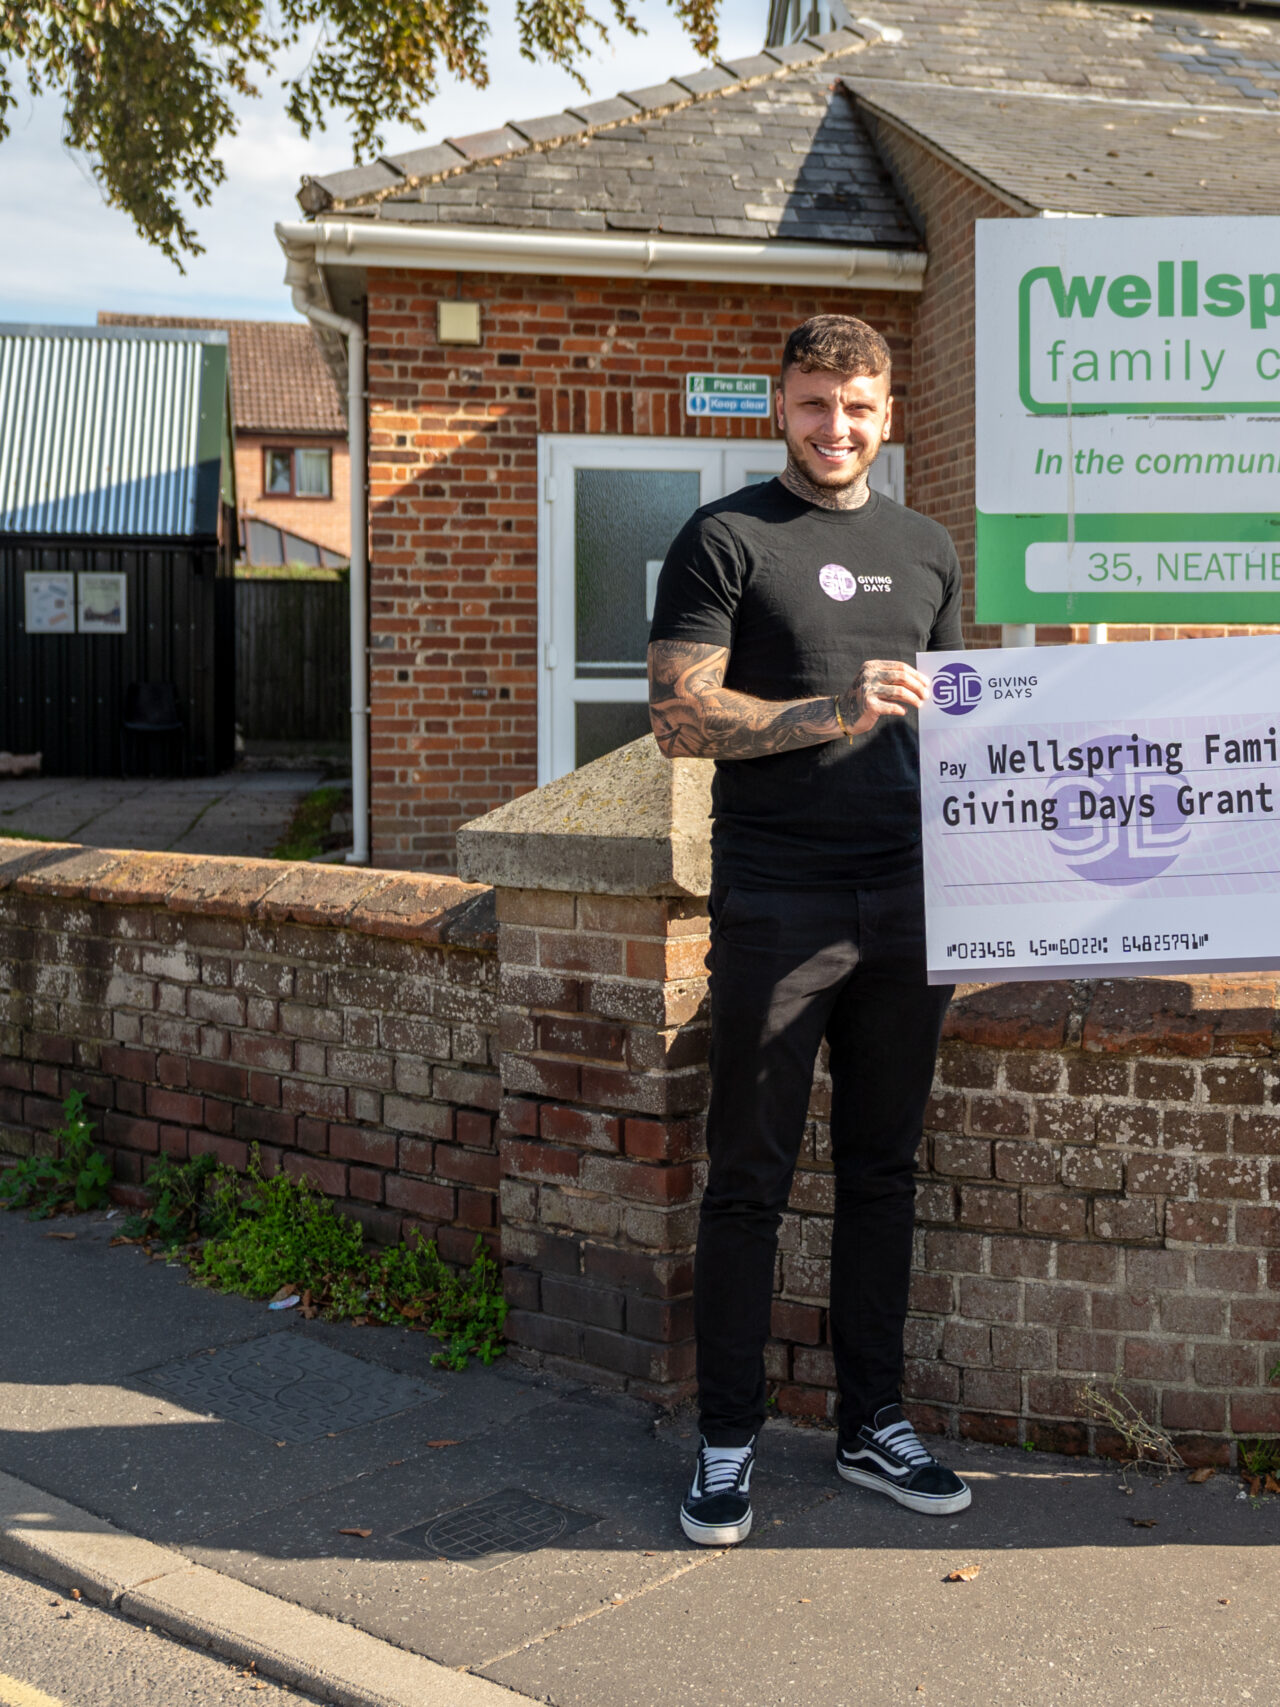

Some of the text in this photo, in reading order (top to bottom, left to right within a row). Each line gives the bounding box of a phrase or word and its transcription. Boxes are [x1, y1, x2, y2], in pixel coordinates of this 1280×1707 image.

[1046, 339, 1227, 391] family
[714, 380, 757, 392] Fire Exit
[711, 399, 765, 412] Keep clear
[1034, 448, 1064, 475] In
[1073, 448, 1124, 475] the
[1087, 553, 1143, 586] 35,
[857, 575, 892, 584] GIVING
[863, 584, 891, 592] DAYS
[988, 676, 1038, 688] GIVING
[994, 688, 1032, 700] DAYS
[940, 761, 967, 779] Pay
[987, 733, 1184, 778] Wellspring
[943, 782, 1274, 831] Giving Days Grant
